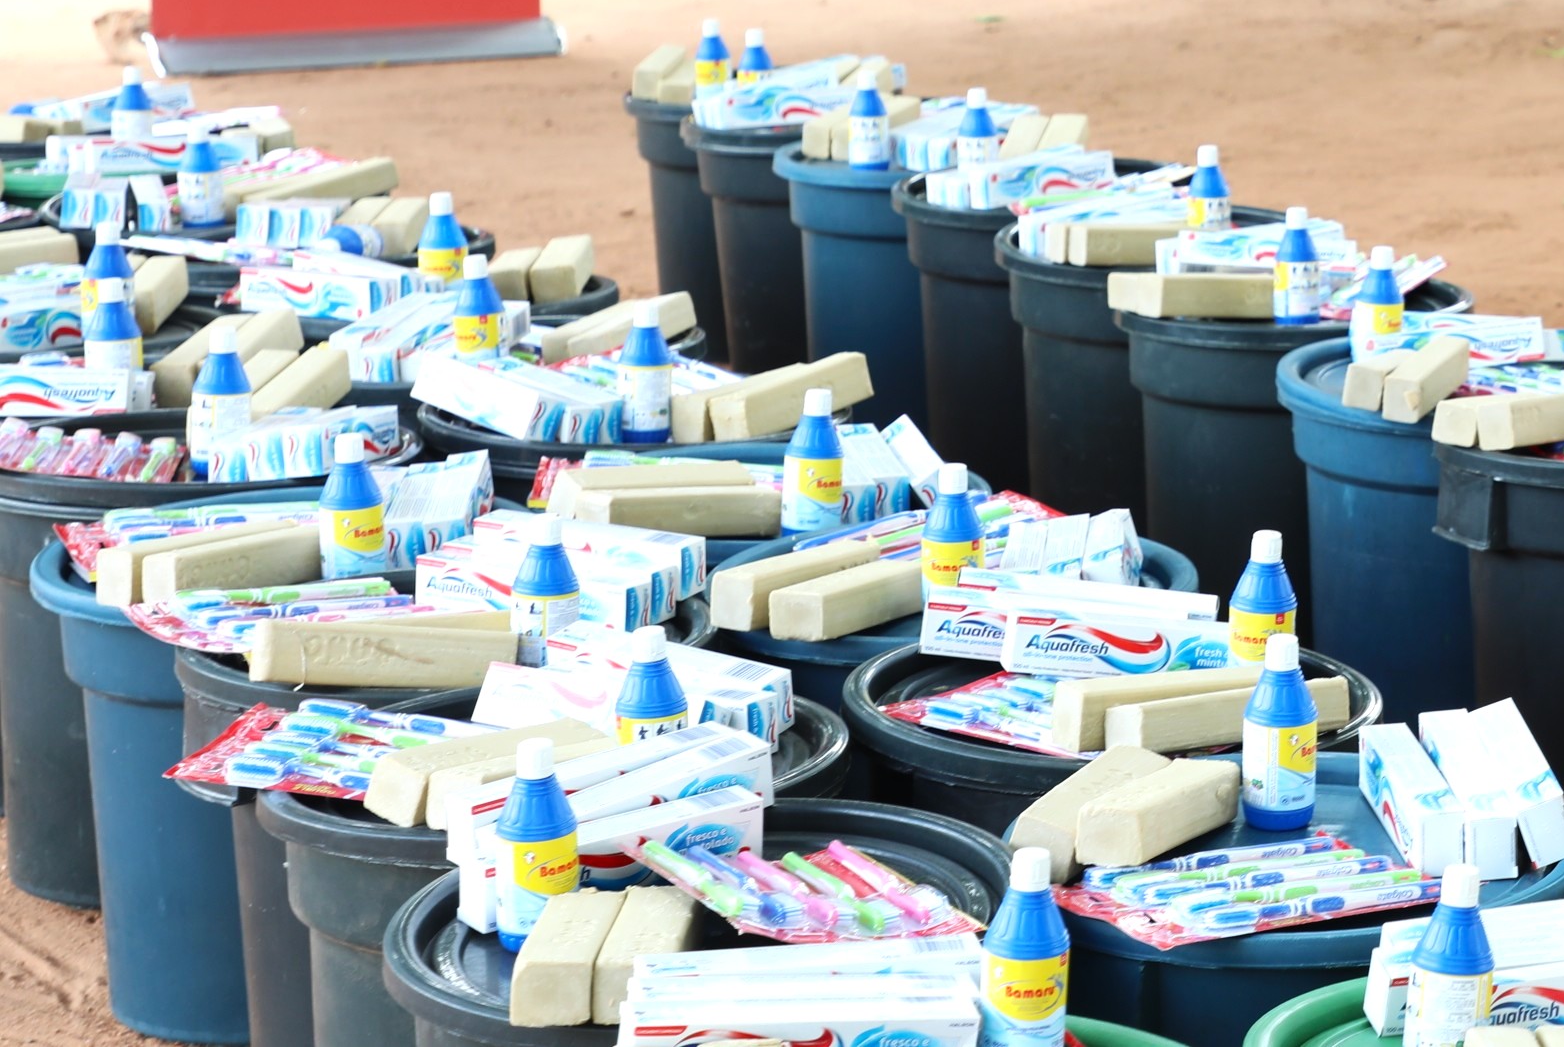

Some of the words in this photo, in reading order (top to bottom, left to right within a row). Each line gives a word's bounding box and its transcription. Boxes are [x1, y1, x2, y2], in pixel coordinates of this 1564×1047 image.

[43, 387, 116, 402] Aquafresh
[427, 577, 493, 599] Aquafresh
[1025, 634, 1109, 657] Aquafresh
[1194, 645, 1222, 659] fresh
[686, 830, 719, 847] fresco
[1261, 846, 1297, 859] Colgate
[1317, 864, 1353, 877] Colgate
[1377, 889, 1413, 901] Colgate
[1488, 1000, 1560, 1027] quafresh
